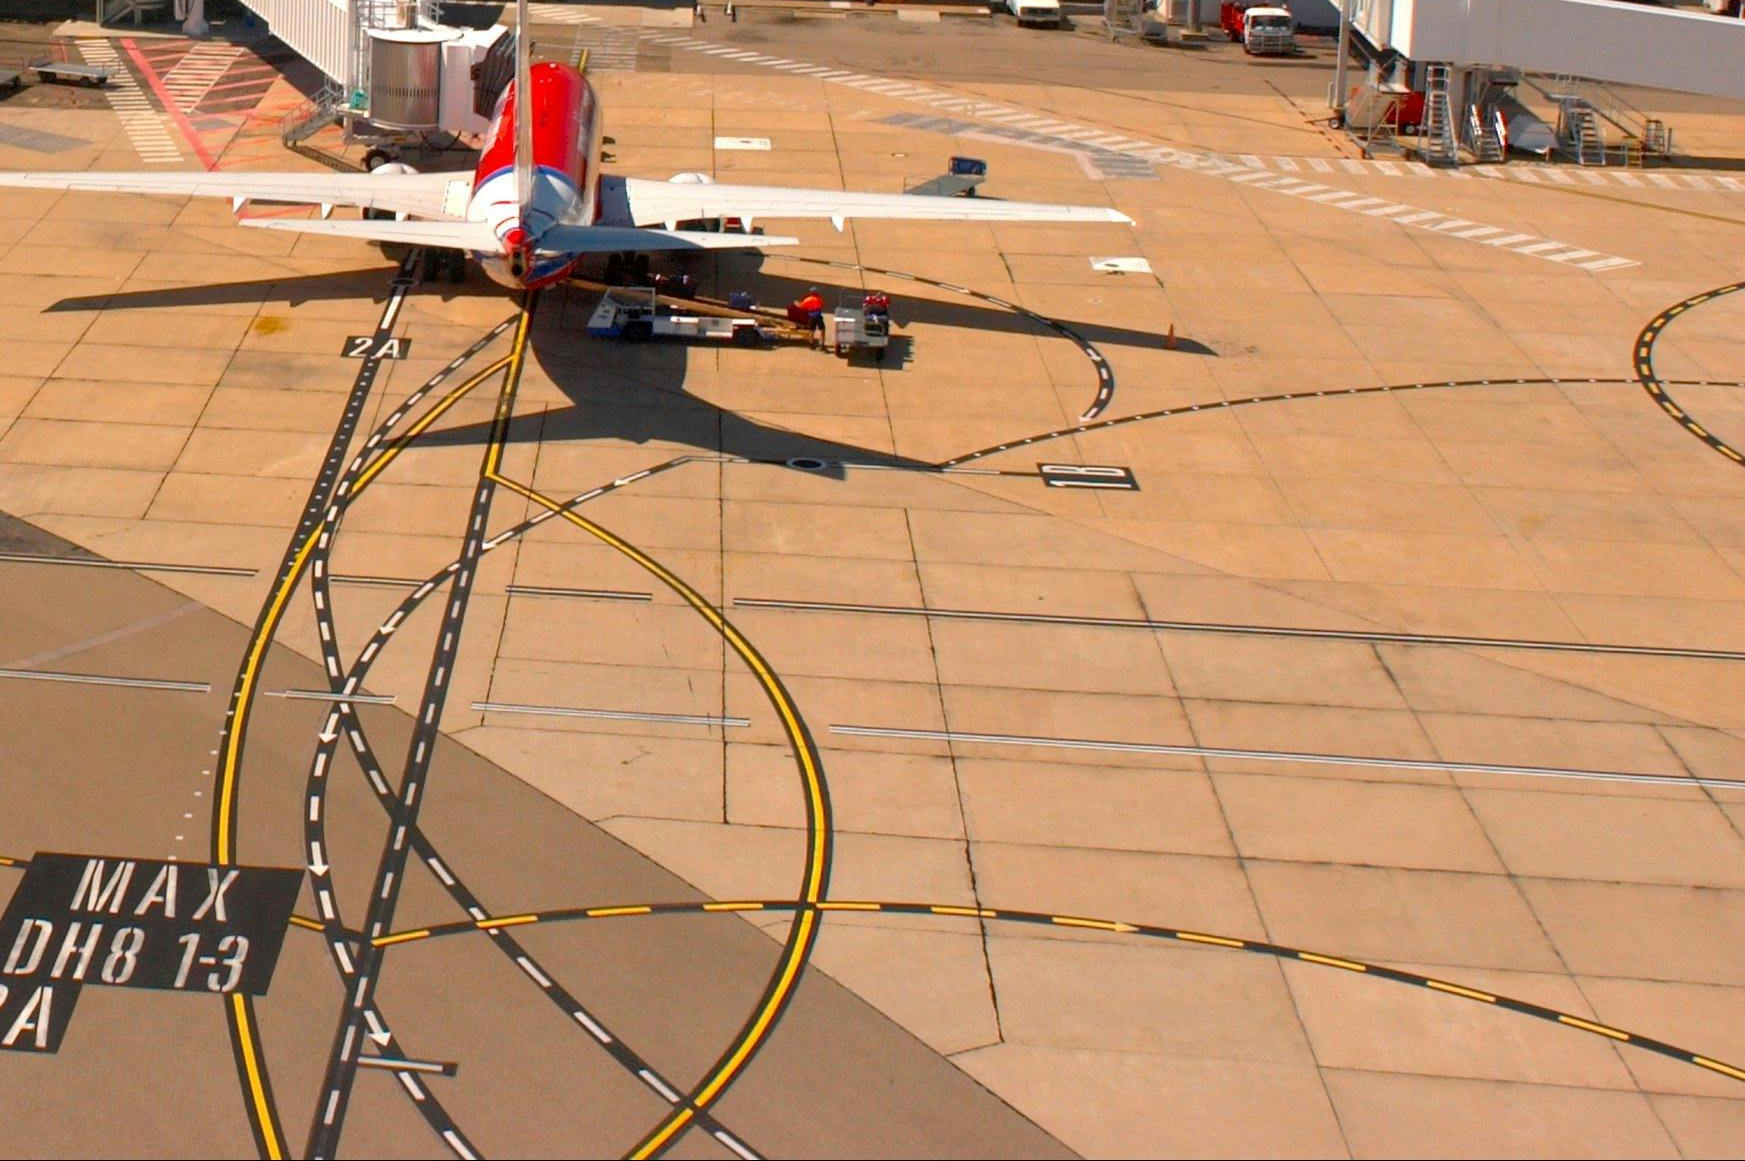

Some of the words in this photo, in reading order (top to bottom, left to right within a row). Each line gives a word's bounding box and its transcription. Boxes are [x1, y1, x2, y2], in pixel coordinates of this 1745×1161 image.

[350, 338, 400, 358] 2A
[70, 859, 240, 922] MAX
[2, 919, 145, 984] DH8
[173, 932, 250, 993] 1-3
